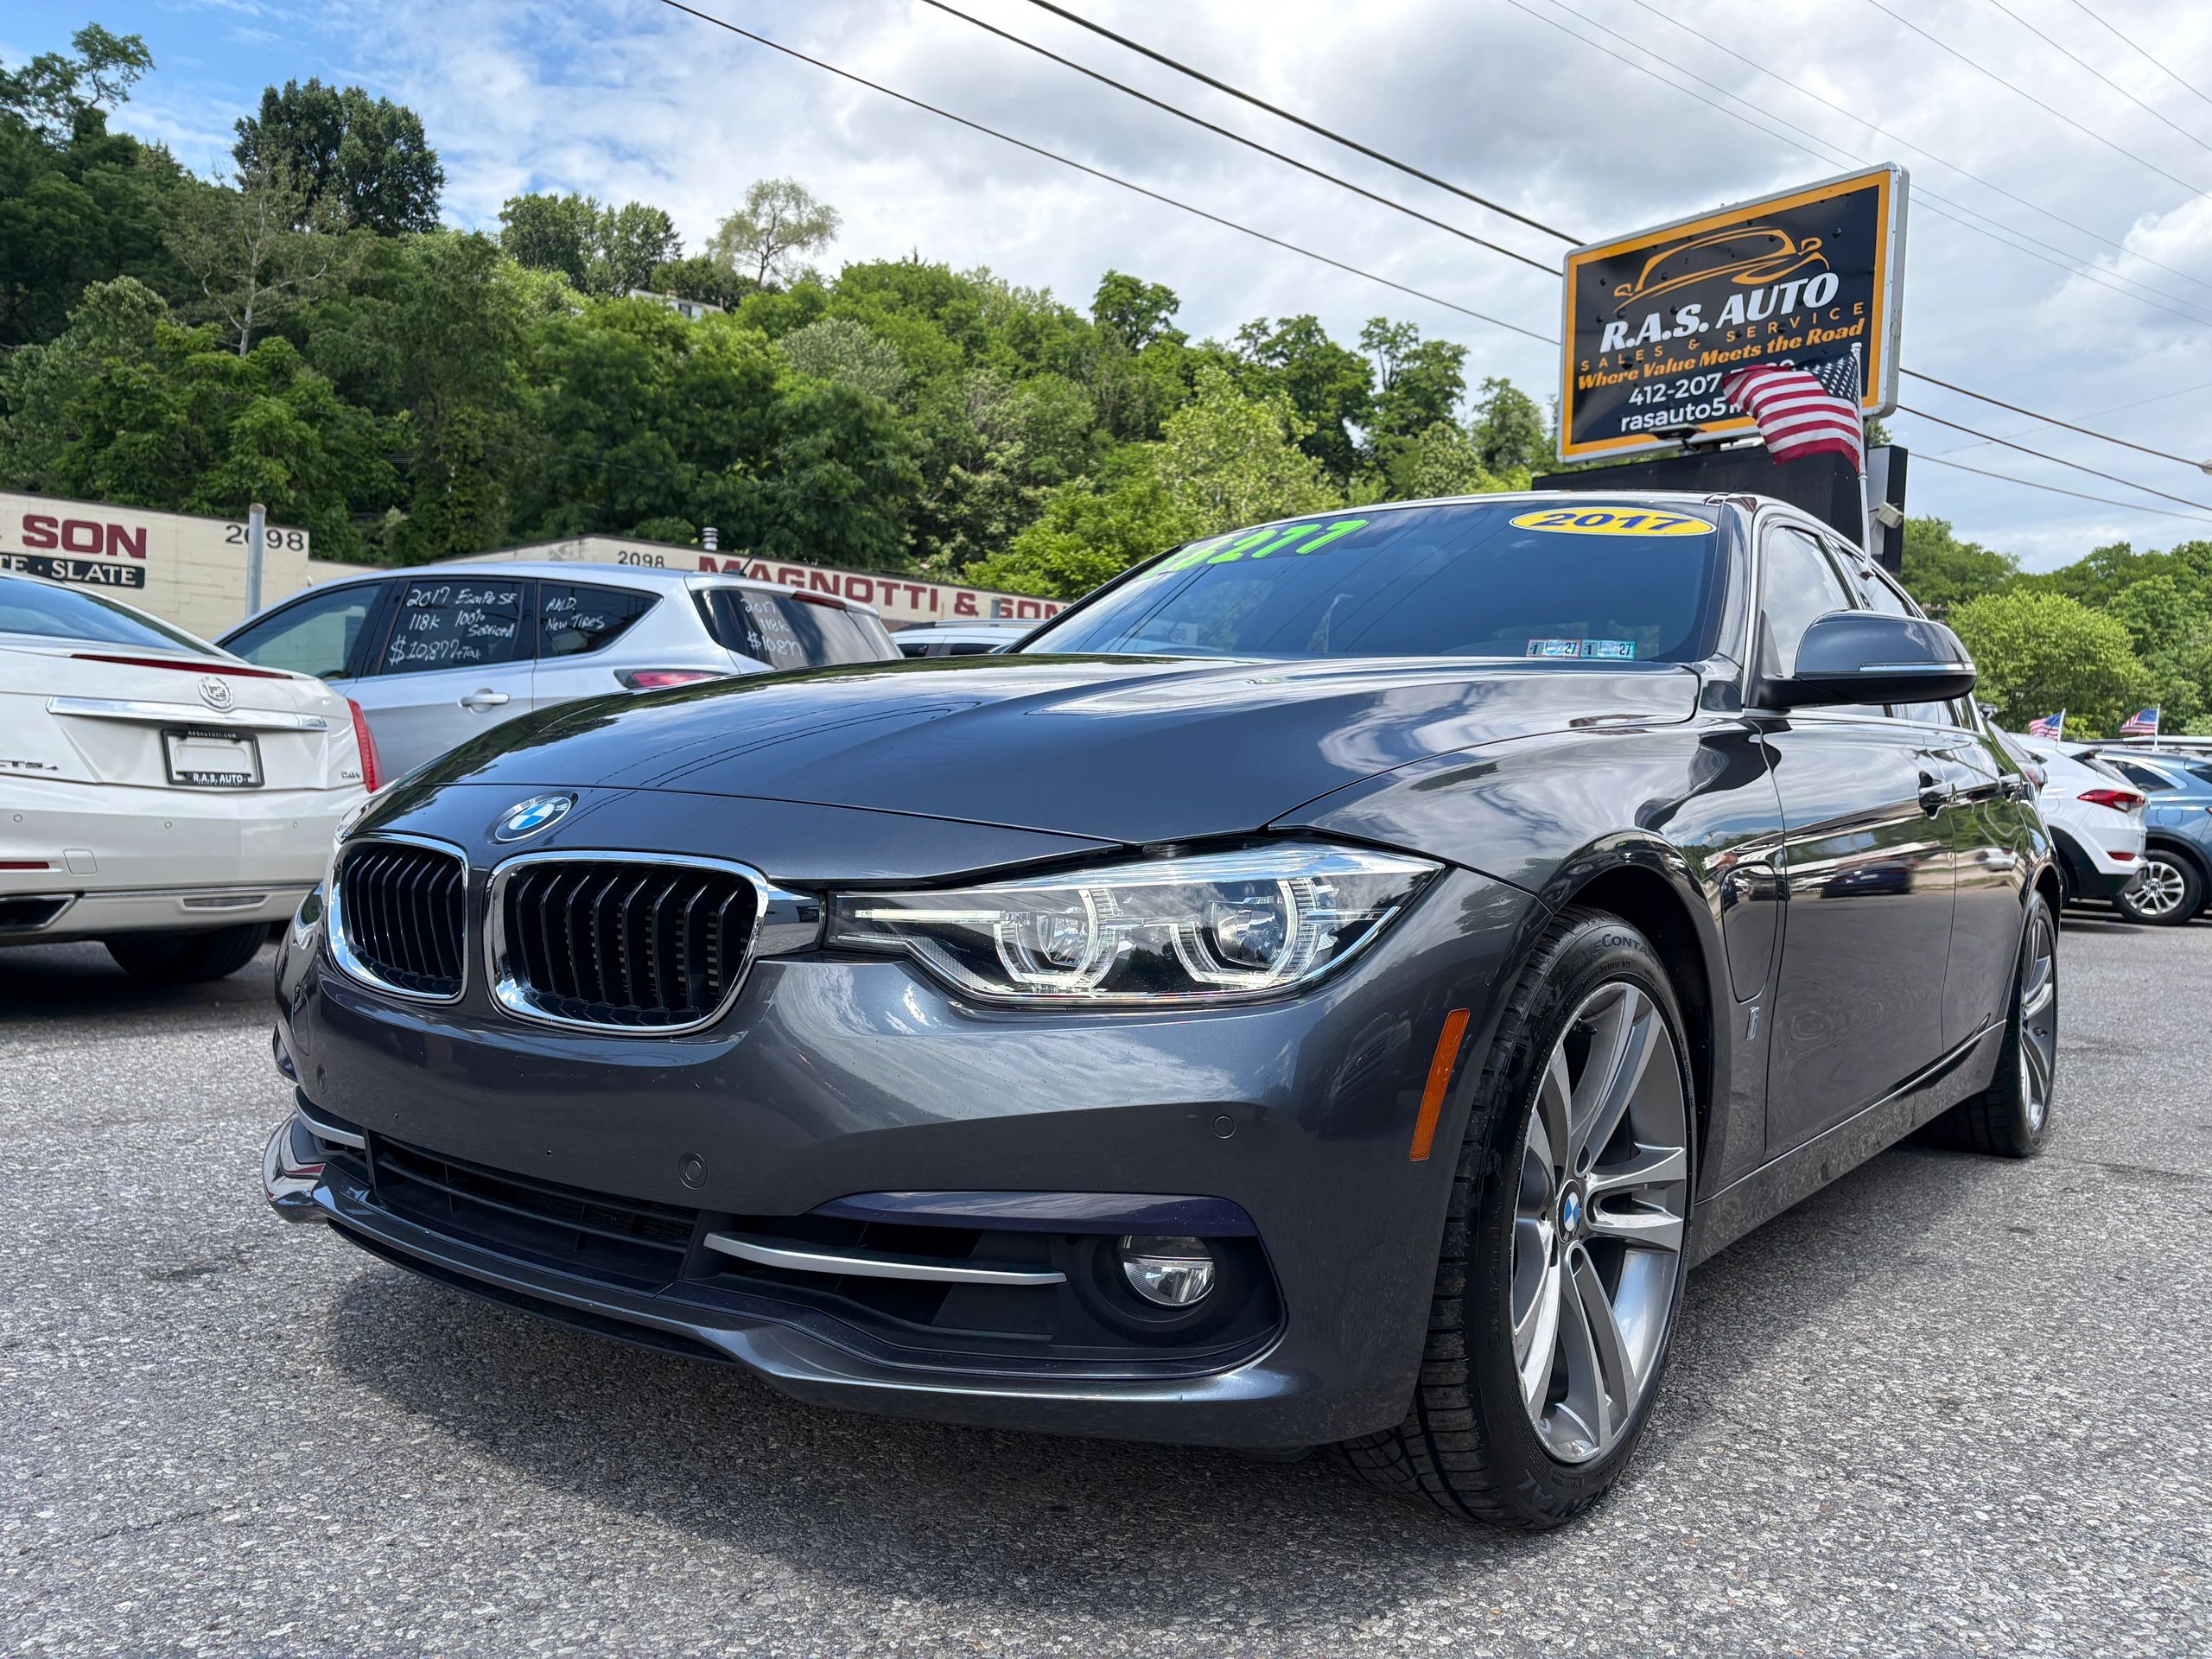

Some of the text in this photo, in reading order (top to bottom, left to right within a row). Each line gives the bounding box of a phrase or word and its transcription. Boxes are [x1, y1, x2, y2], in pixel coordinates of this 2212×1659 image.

[1599, 272, 1840, 353] R.A.S. AUTO
[1580, 302, 1864, 372] SALES & SERVICE
[1578, 317, 1865, 391] Where Value Meets the Road
[1529, 512, 1694, 531] 2017
[22, 513, 147, 559] SON
[226, 524, 304, 552] 298
[618, 550, 665, 568] 2098
[51, 559, 137, 586] SLATE
[406, 586, 451, 607] 2017
[699, 556, 938, 613] MAGNOTTI
[954, 592, 980, 617] &
[740, 598, 776, 614] 2017
[454, 608, 486, 628] 100%
[545, 617, 568, 632] New
[1564, 642, 1578, 655] 27
[1618, 643, 1632, 657] 27
[219, 773, 244, 784] AUTO
